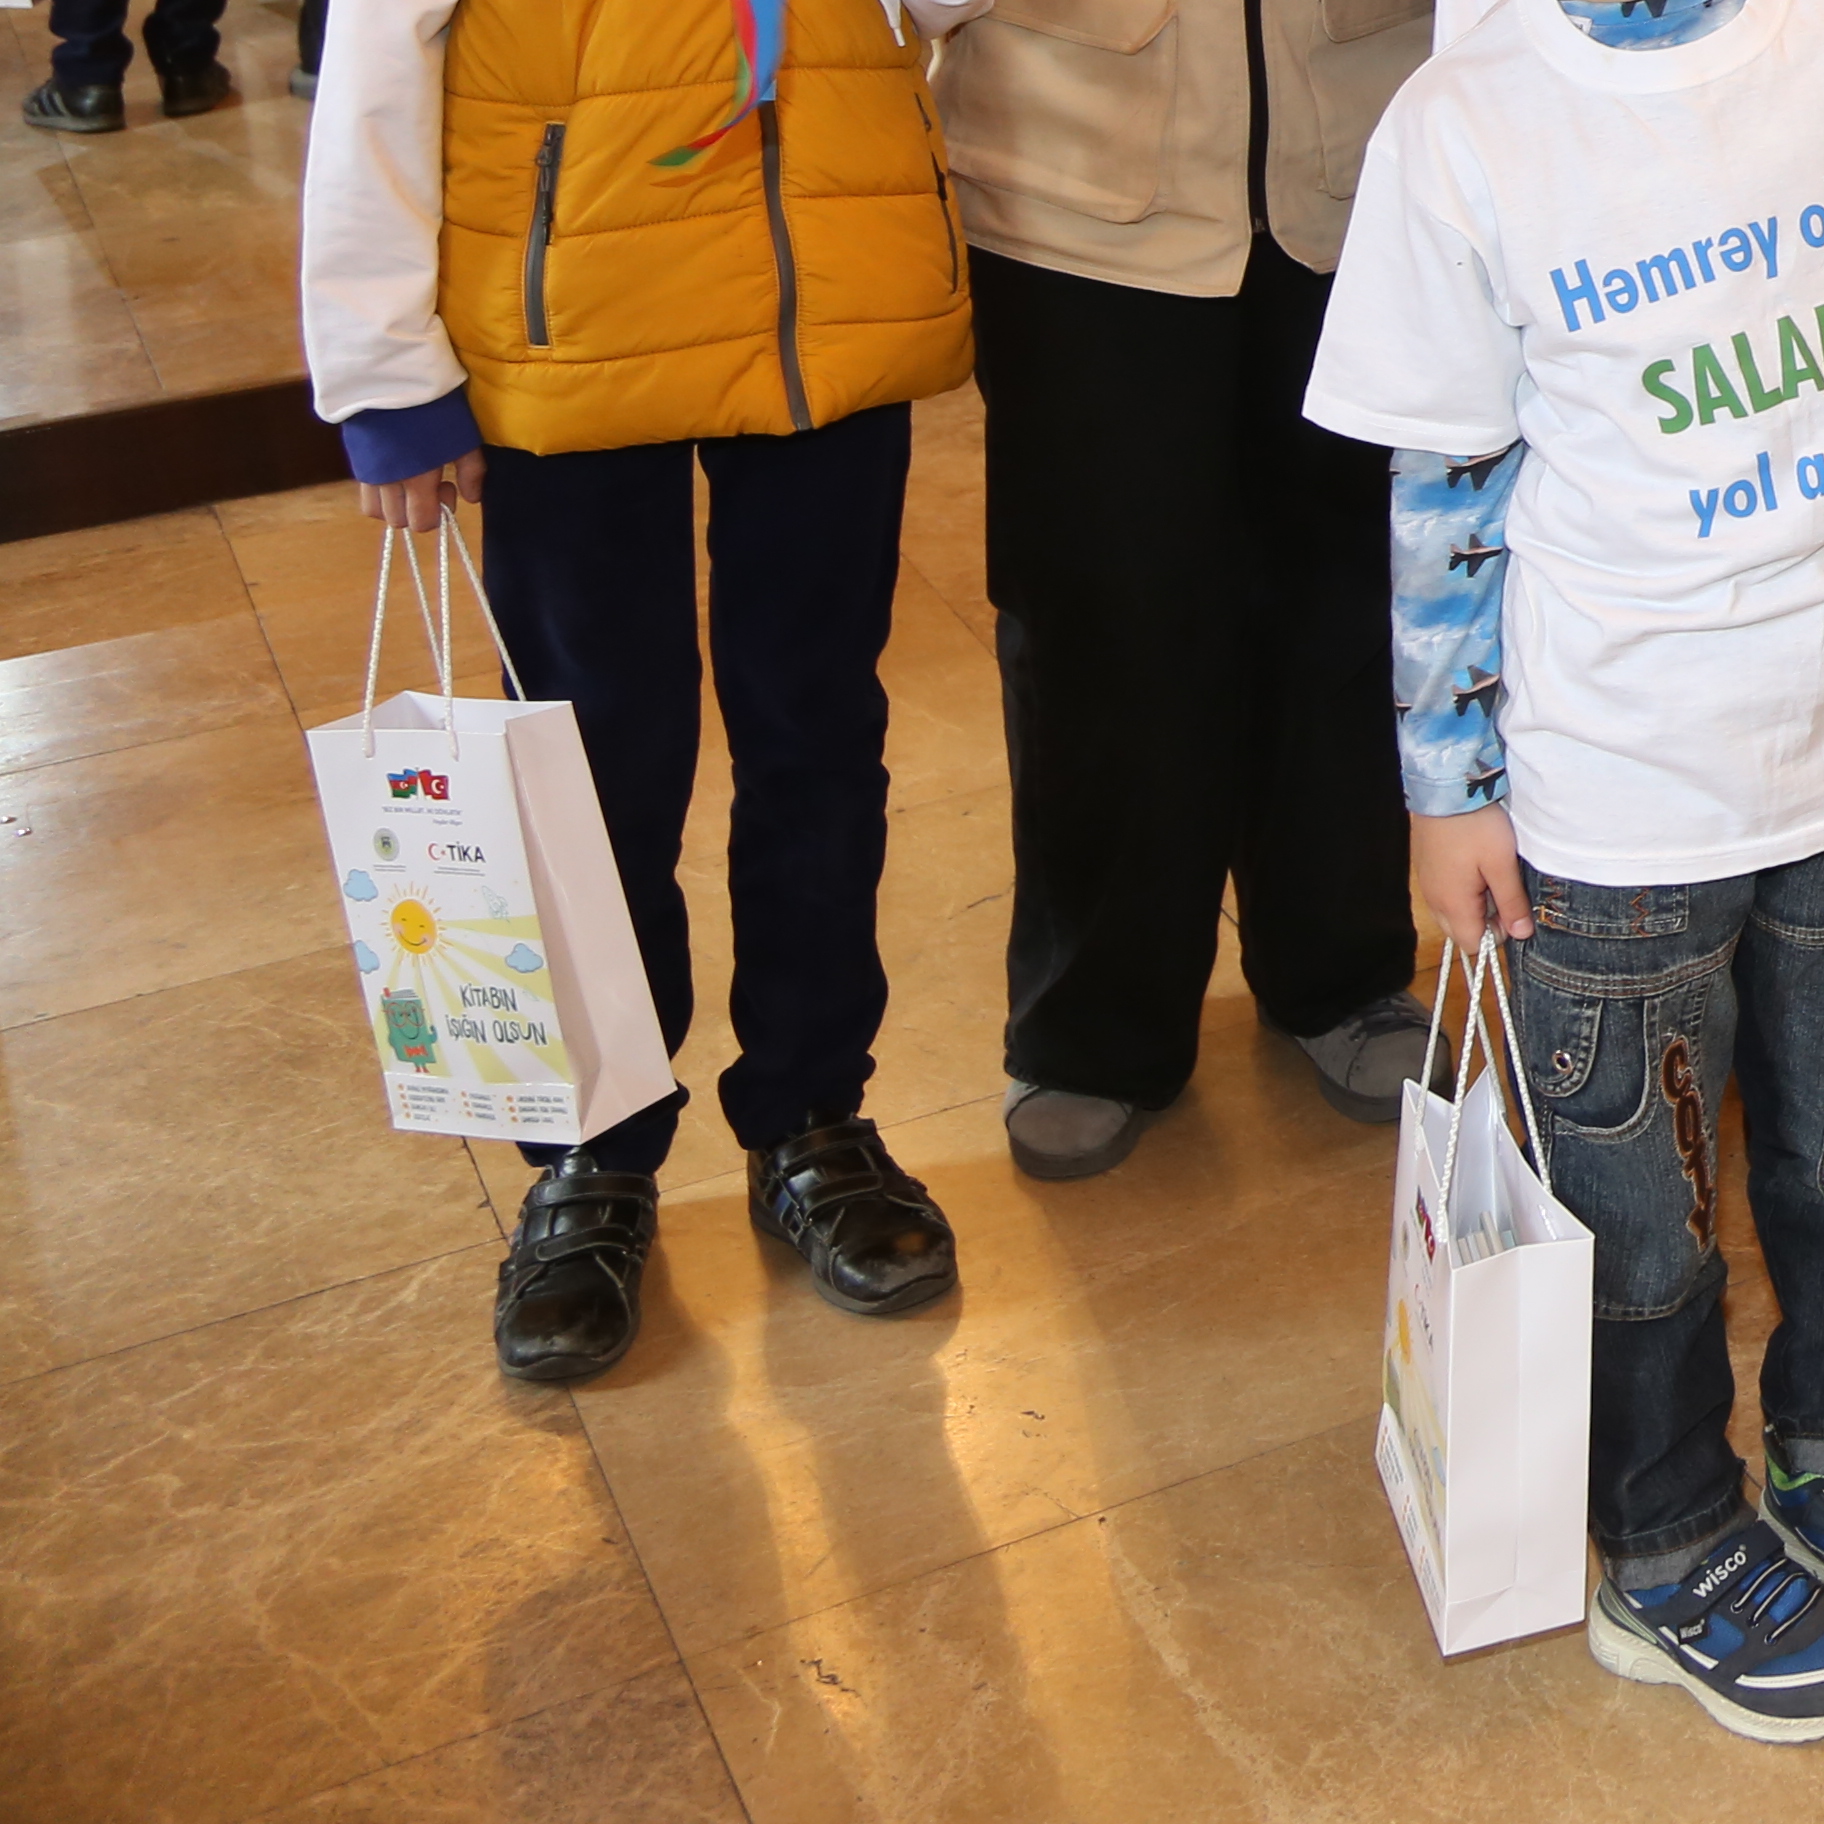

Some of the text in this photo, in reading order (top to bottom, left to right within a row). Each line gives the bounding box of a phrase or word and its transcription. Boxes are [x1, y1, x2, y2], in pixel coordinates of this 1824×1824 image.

[1549, 214, 1780, 333] Həmrəy
[1689, 450, 1780, 539] yol
[445, 840, 487, 864] TİKA
[458, 981, 518, 1012] KİTABIN
[445, 1013, 548, 1047] İŞIĞIN OLSUN
[1692, 1548, 1748, 1599] wisco
